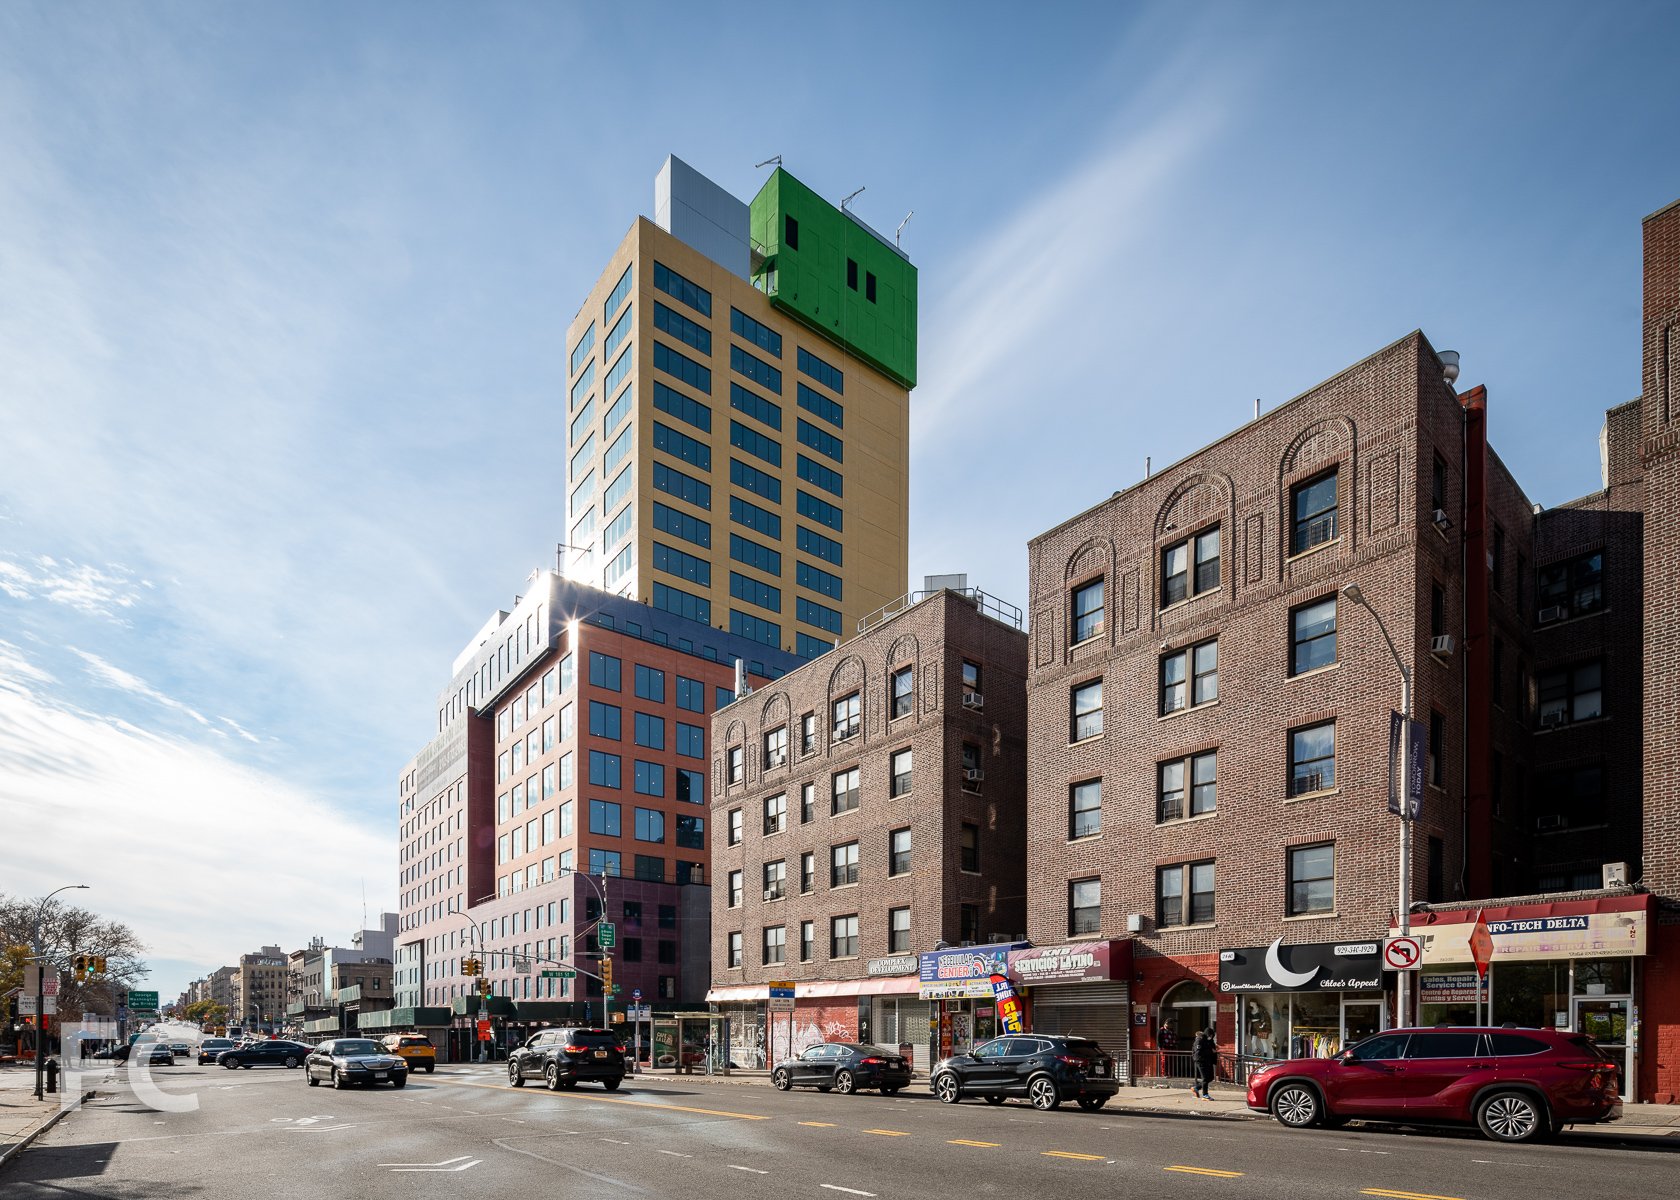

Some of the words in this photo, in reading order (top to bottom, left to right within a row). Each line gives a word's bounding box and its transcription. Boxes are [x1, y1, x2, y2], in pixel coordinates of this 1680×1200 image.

[1486, 920, 1543, 933] NFO-TECH
[1546, 918, 1586, 929] DELTA
[1501, 945, 1540, 953] REPAIR
[1014, 957, 1058, 973] SERVICIOS
[1060, 953, 1094, 969] LATINO
[938, 966, 969, 978] CENTER
[1320, 979, 1346, 987] Chloe's
[1348, 978, 1379, 989] Appeal
